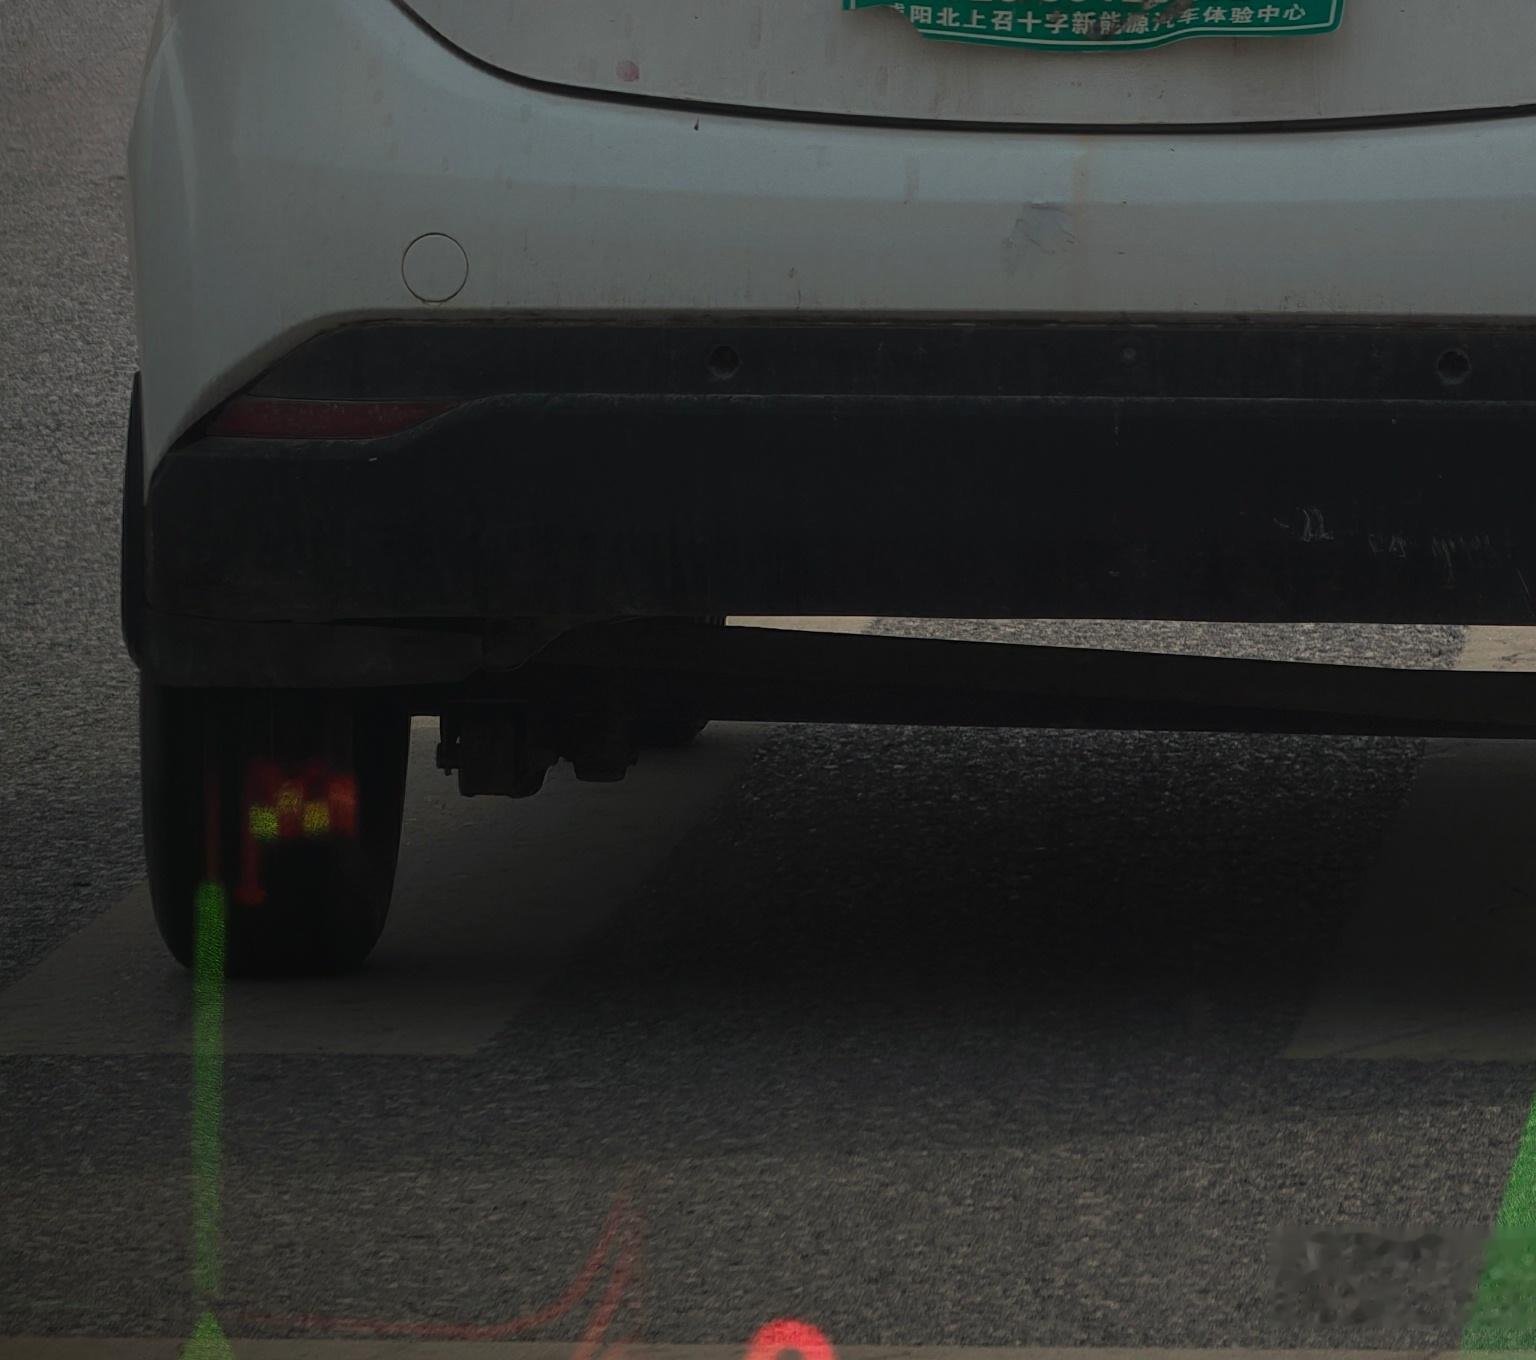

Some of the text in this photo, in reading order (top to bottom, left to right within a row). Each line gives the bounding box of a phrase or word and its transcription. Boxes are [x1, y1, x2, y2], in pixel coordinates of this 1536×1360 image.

[892, 1, 1307, 36] 阳北上召十字新能源汽车体验中心
